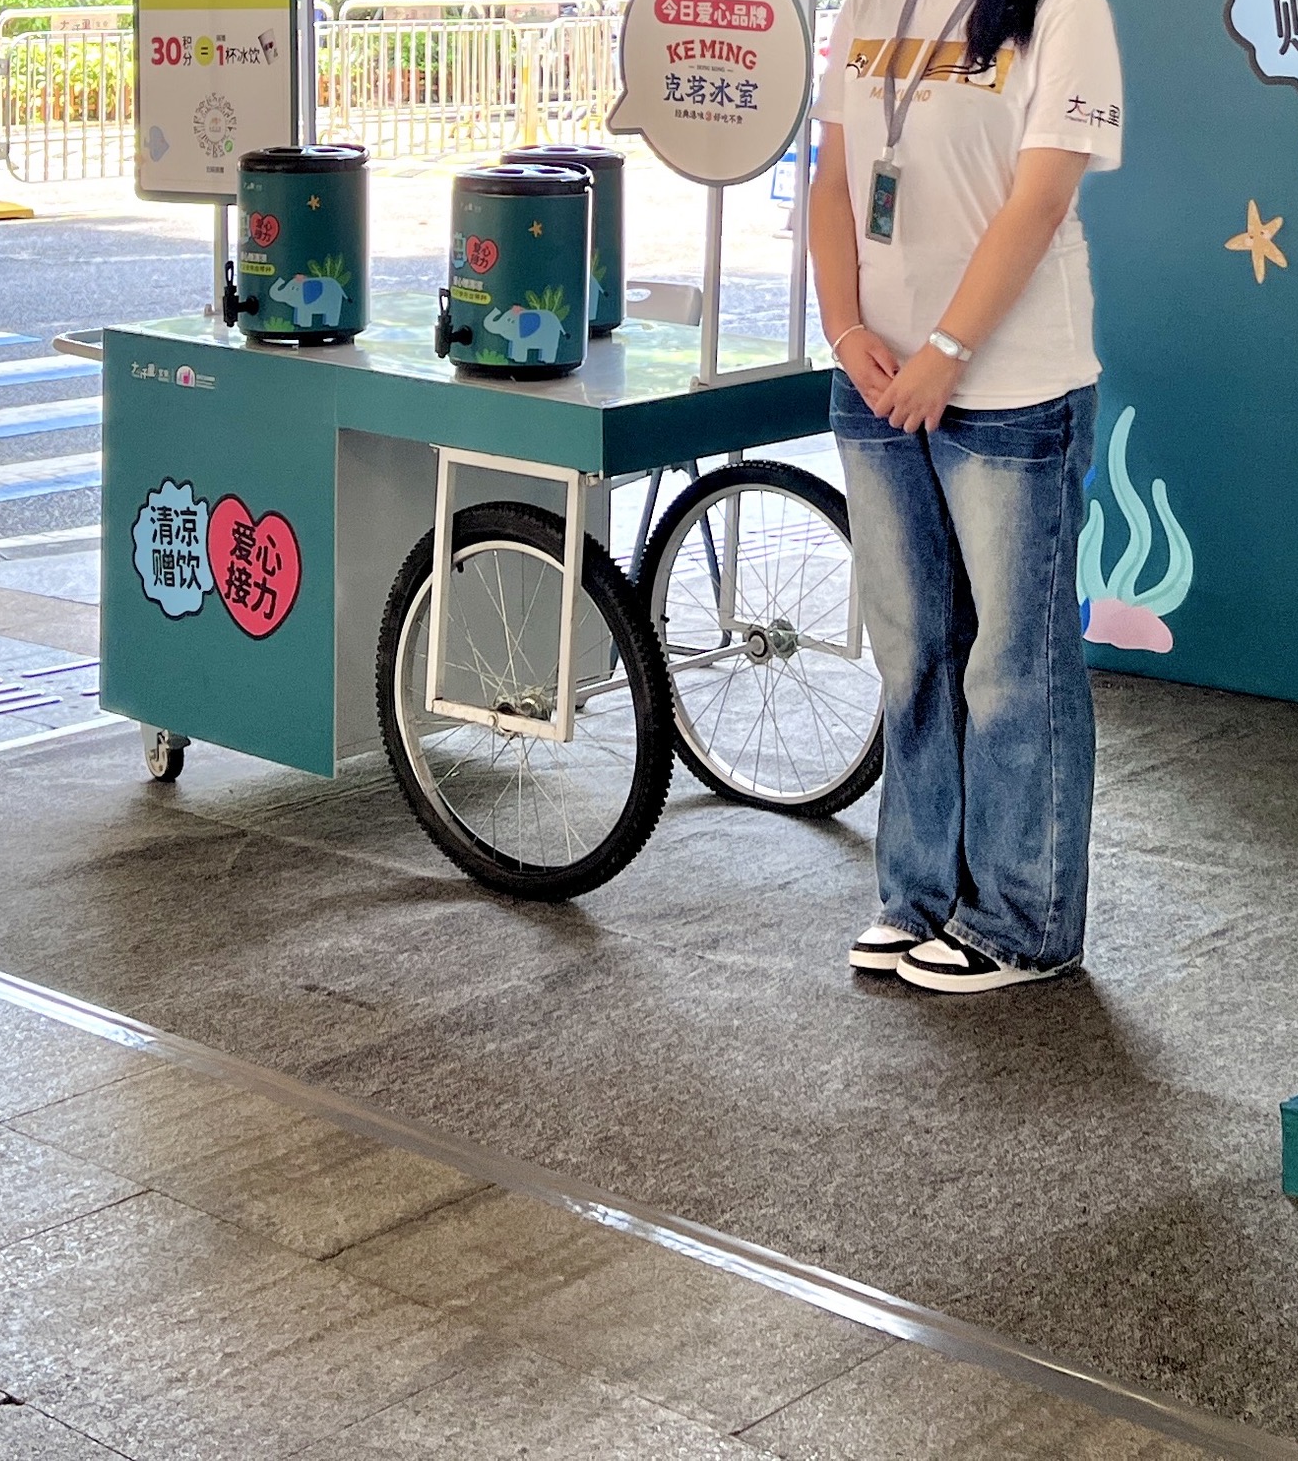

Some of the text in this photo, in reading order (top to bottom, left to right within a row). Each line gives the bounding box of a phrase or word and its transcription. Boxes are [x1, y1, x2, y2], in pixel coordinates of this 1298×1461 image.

[151, 37, 181, 65] 30
[664, 73, 758, 110] 克茗冰室
[1066, 95, 1120, 127] 大仟里
[150, 505, 199, 547] 清凉
[230, 520, 282, 577] 爱心
[151, 549, 202, 591] 赠饮
[225, 562, 277, 620] 接力
